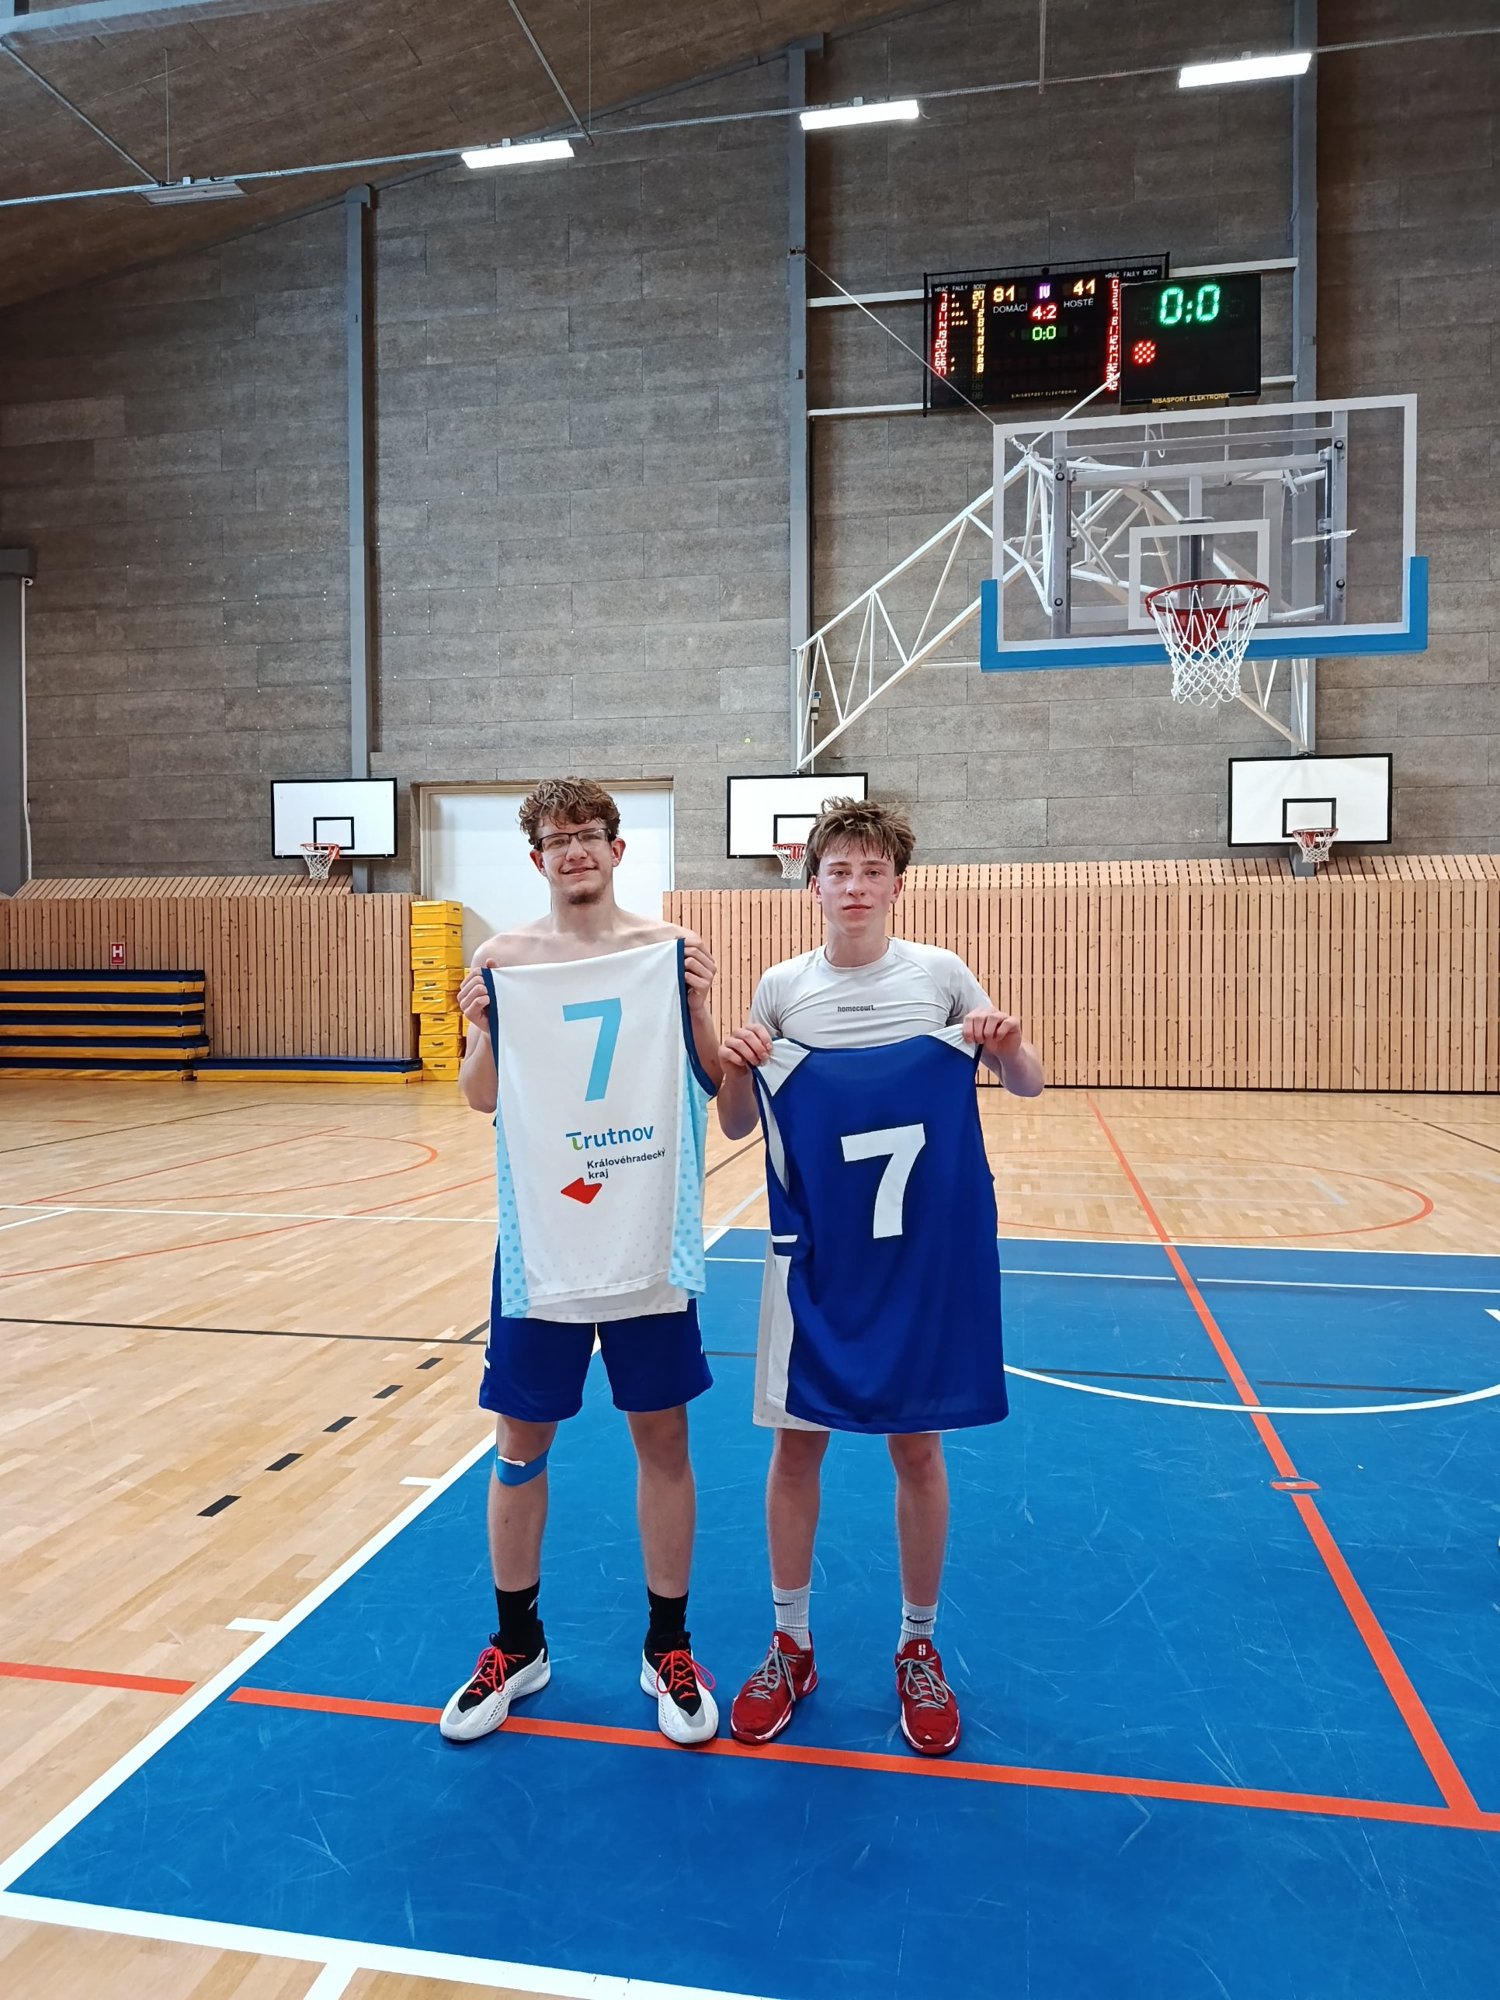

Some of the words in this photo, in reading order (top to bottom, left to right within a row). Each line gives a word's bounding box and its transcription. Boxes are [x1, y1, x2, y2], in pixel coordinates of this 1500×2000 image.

[1073, 278, 1096, 296] 41
[942, 293, 948, 302] 7
[972, 290, 985, 300] 20
[993, 285, 1015, 302] 81
[940, 302, 948, 311] 8
[972, 300, 985, 309] 21
[993, 303, 1028, 313] DOMÁCÍ
[1064, 298, 1094, 308] HOSTÉ
[1160, 284, 1220, 325] 0:0
[939, 312, 948, 320] 11
[978, 309, 985, 317] 2
[1032, 305, 1056, 320] 4:2
[939, 330, 948, 338] 19
[1032, 326, 1056, 340] 0:0
[935, 339, 948, 348] 20
[935, 348, 947, 357] 22
[934, 358, 947, 366] 66
[1152, 396, 1187, 404] NISASPORT
[1189, 393, 1230, 401] ELEKTRONIK
[112, 945, 123, 957] H
[562, 997, 622, 1102] 7
[587, 1147, 666, 1169] Královéhradecký
[588, 1169, 609, 1179] kraj
[840, 1123, 926, 1240] 7
